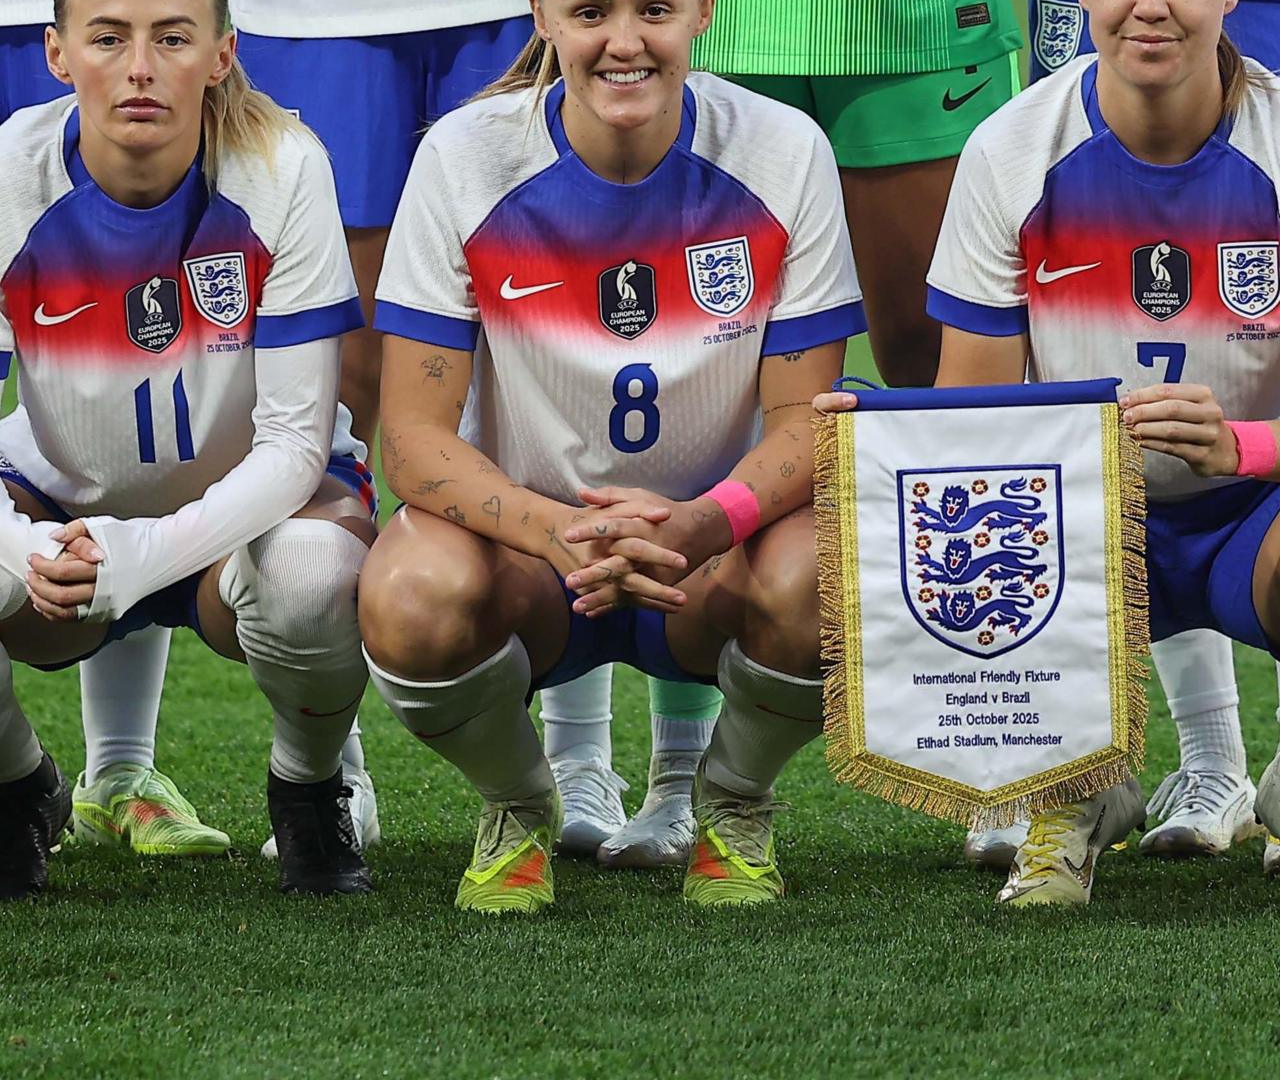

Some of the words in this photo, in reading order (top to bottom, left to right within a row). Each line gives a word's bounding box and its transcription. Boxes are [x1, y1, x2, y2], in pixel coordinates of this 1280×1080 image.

[1151, 282, 1172, 290] UEFA
[611, 310, 645, 318] EUROPEAN
[610, 316, 647, 325] CHAMPIONS
[718, 320, 742, 331] BRAZIL
[138, 321, 170, 333] EUROPEAN
[620, 324, 640, 332] 2025
[1242, 323, 1266, 331] BRAZIL
[137, 328, 174, 340] CHAMPIONS
[703, 336, 712, 344] 25
[713, 331, 741, 343] OCTOBER
[1226, 333, 1235, 341] 25
[1236, 332, 1265, 340] OCTOBER
[148, 337, 167, 347] 2025
[207, 344, 214, 352] 25
[215, 343, 241, 352] OCTOBER
[1137, 342, 1187, 384] 7
[609, 363, 660, 454] 8
[135, 370, 195, 463] 11
[913, 672, 976, 685] International
[1025, 671, 1060, 682] Fixture
[946, 692, 987, 707] England
[991, 694, 998, 704] v
[1002, 692, 1030, 704] Brazil
[938, 714, 962, 727] 25th
[966, 713, 1008, 726] October
[1012, 713, 1040, 724] 2025
[917, 736, 949, 749] Etihad
[1002, 734, 1062, 746] Manchester
